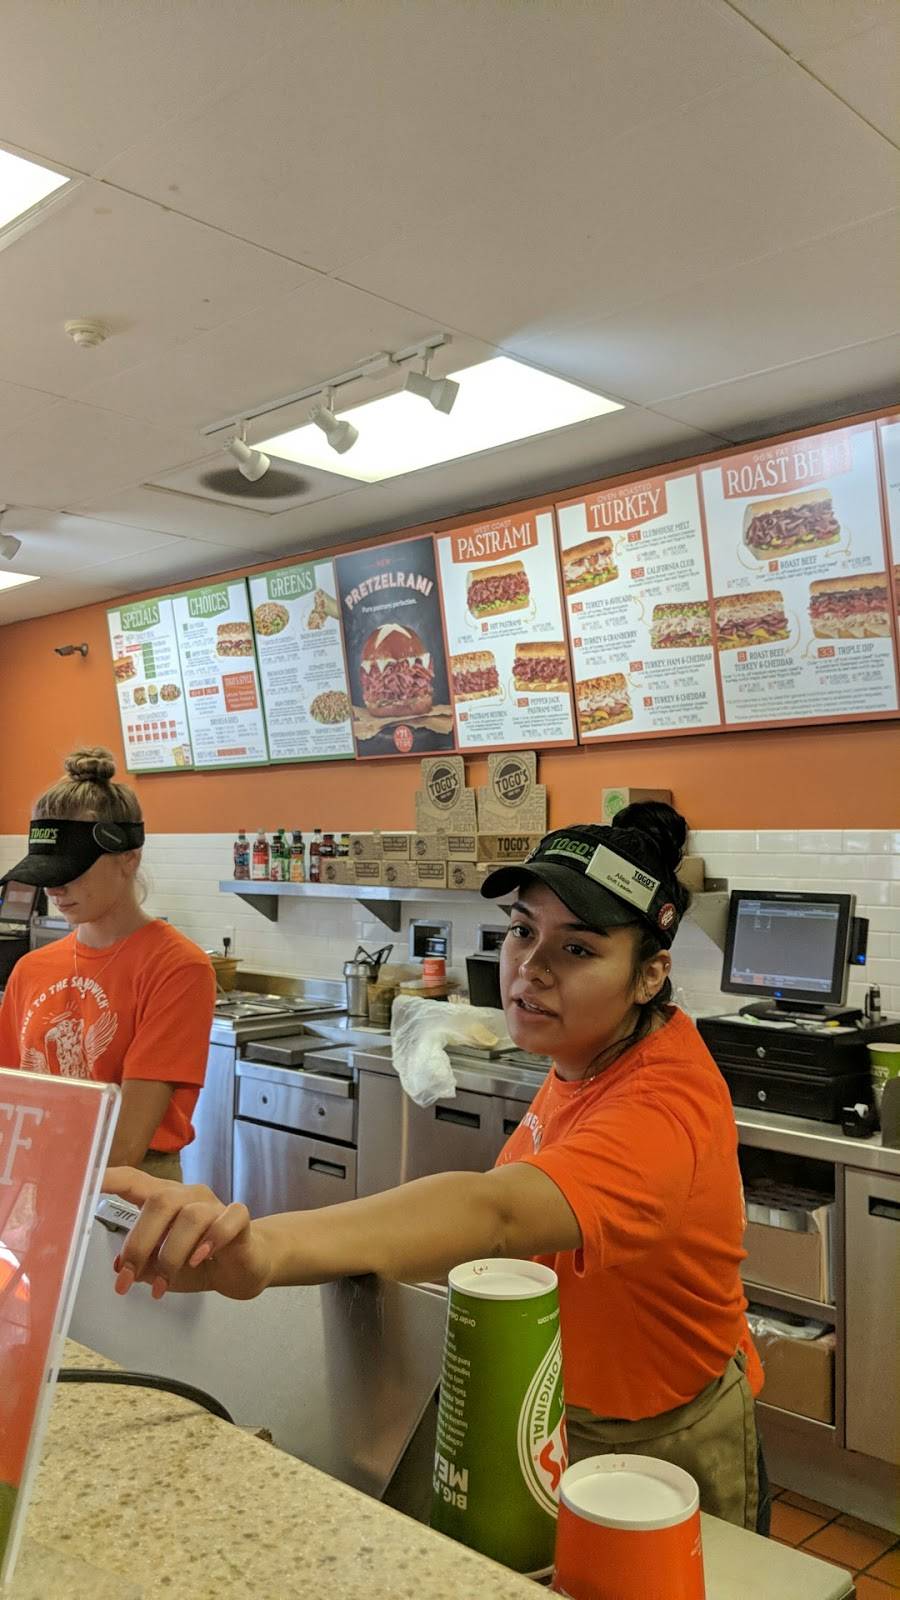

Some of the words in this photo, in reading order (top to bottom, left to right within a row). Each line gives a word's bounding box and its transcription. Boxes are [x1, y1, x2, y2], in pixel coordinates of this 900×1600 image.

[726, 456, 789, 496] ROAST
[794, 444, 847, 481] BE
[619, 482, 652, 498] ROASTED
[590, 488, 661, 529] TURKEY
[474, 525, 492, 534] WEST
[492, 519, 512, 530] COAST
[457, 522, 532, 560] PASTRAMI
[780, 558, 800, 570] ROAST
[801, 555, 818, 566] BEEF
[270, 571, 314, 598] GREENS
[344, 571, 434, 611] PRETZELRAMI
[190, 591, 230, 617] CHOICES
[121, 606, 160, 630] SPECIALS
[429, 773, 458, 796] TOGO'S
[495, 768, 529, 793] TOGO'S
[30, 827, 59, 839] TOGO'S
[497, 837, 530, 851] TOGO'S
[634, 870, 656, 888] TOGO'S
[33, 993, 47, 1008] TO
[48, 978, 69, 995] THE
[70, 976, 110, 1009] SANDWICH
[533, 1361, 560, 1446] ORIGINAL
